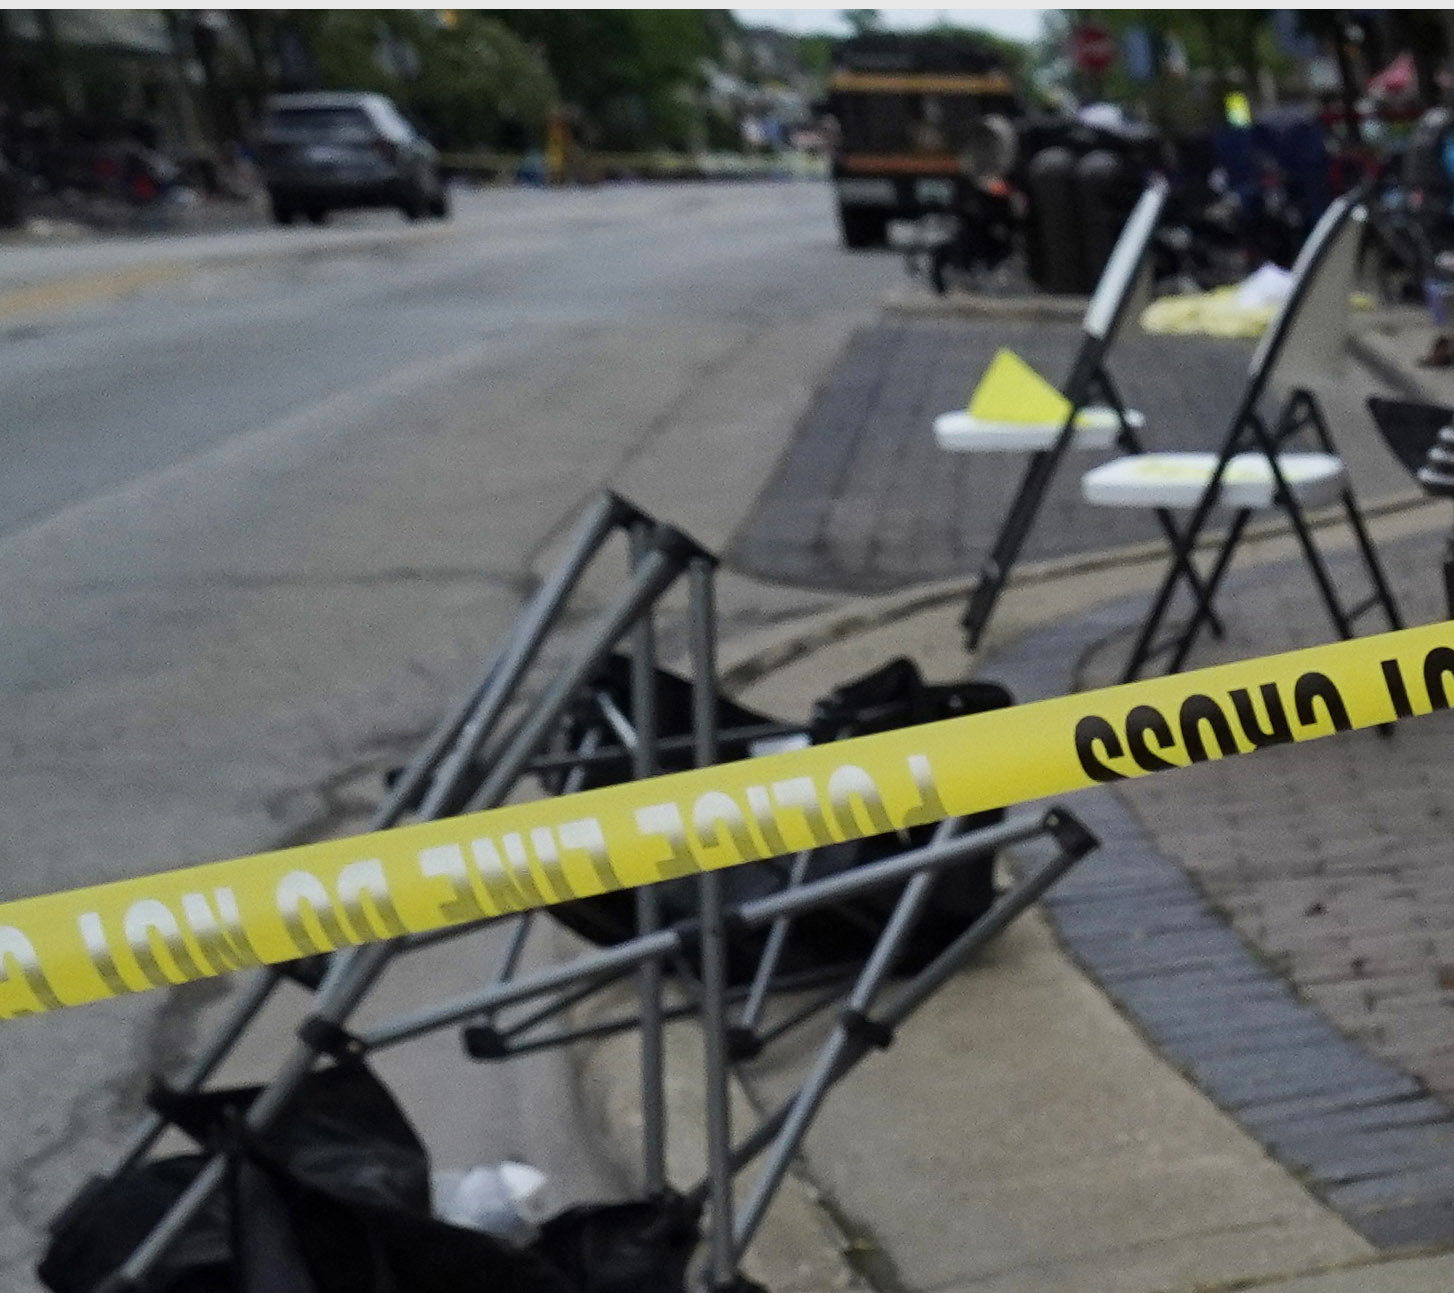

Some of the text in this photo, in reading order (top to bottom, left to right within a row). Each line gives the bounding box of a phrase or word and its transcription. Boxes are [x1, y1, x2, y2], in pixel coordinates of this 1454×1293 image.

[1070, 667, 1352, 787] CROSS
[417, 815, 621, 925] LINE
[633, 752, 947, 879] POLICE
[76, 883, 253, 995] NOT
[272, 855, 400, 956] DO
